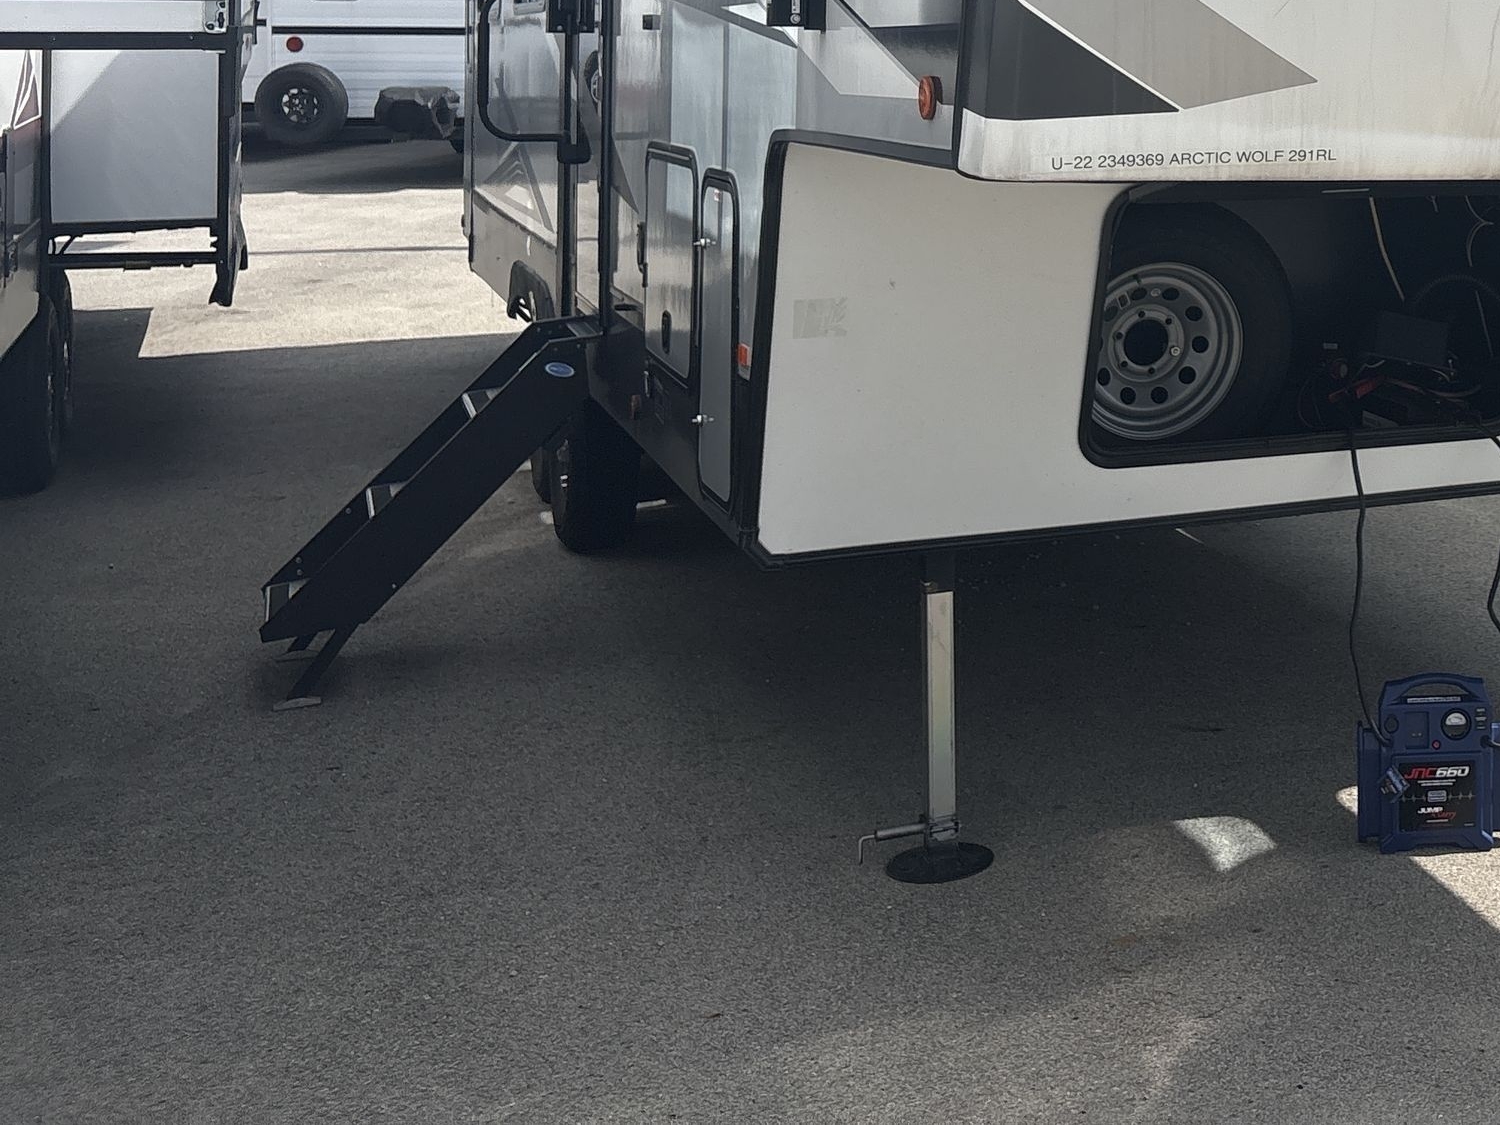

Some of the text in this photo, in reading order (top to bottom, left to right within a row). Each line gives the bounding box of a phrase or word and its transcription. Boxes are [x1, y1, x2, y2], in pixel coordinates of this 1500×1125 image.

[1051, 148, 1337, 171] U-22 2349369 ARCTIC WOLF 291RL
[1417, 806, 1444, 814] JUMP
